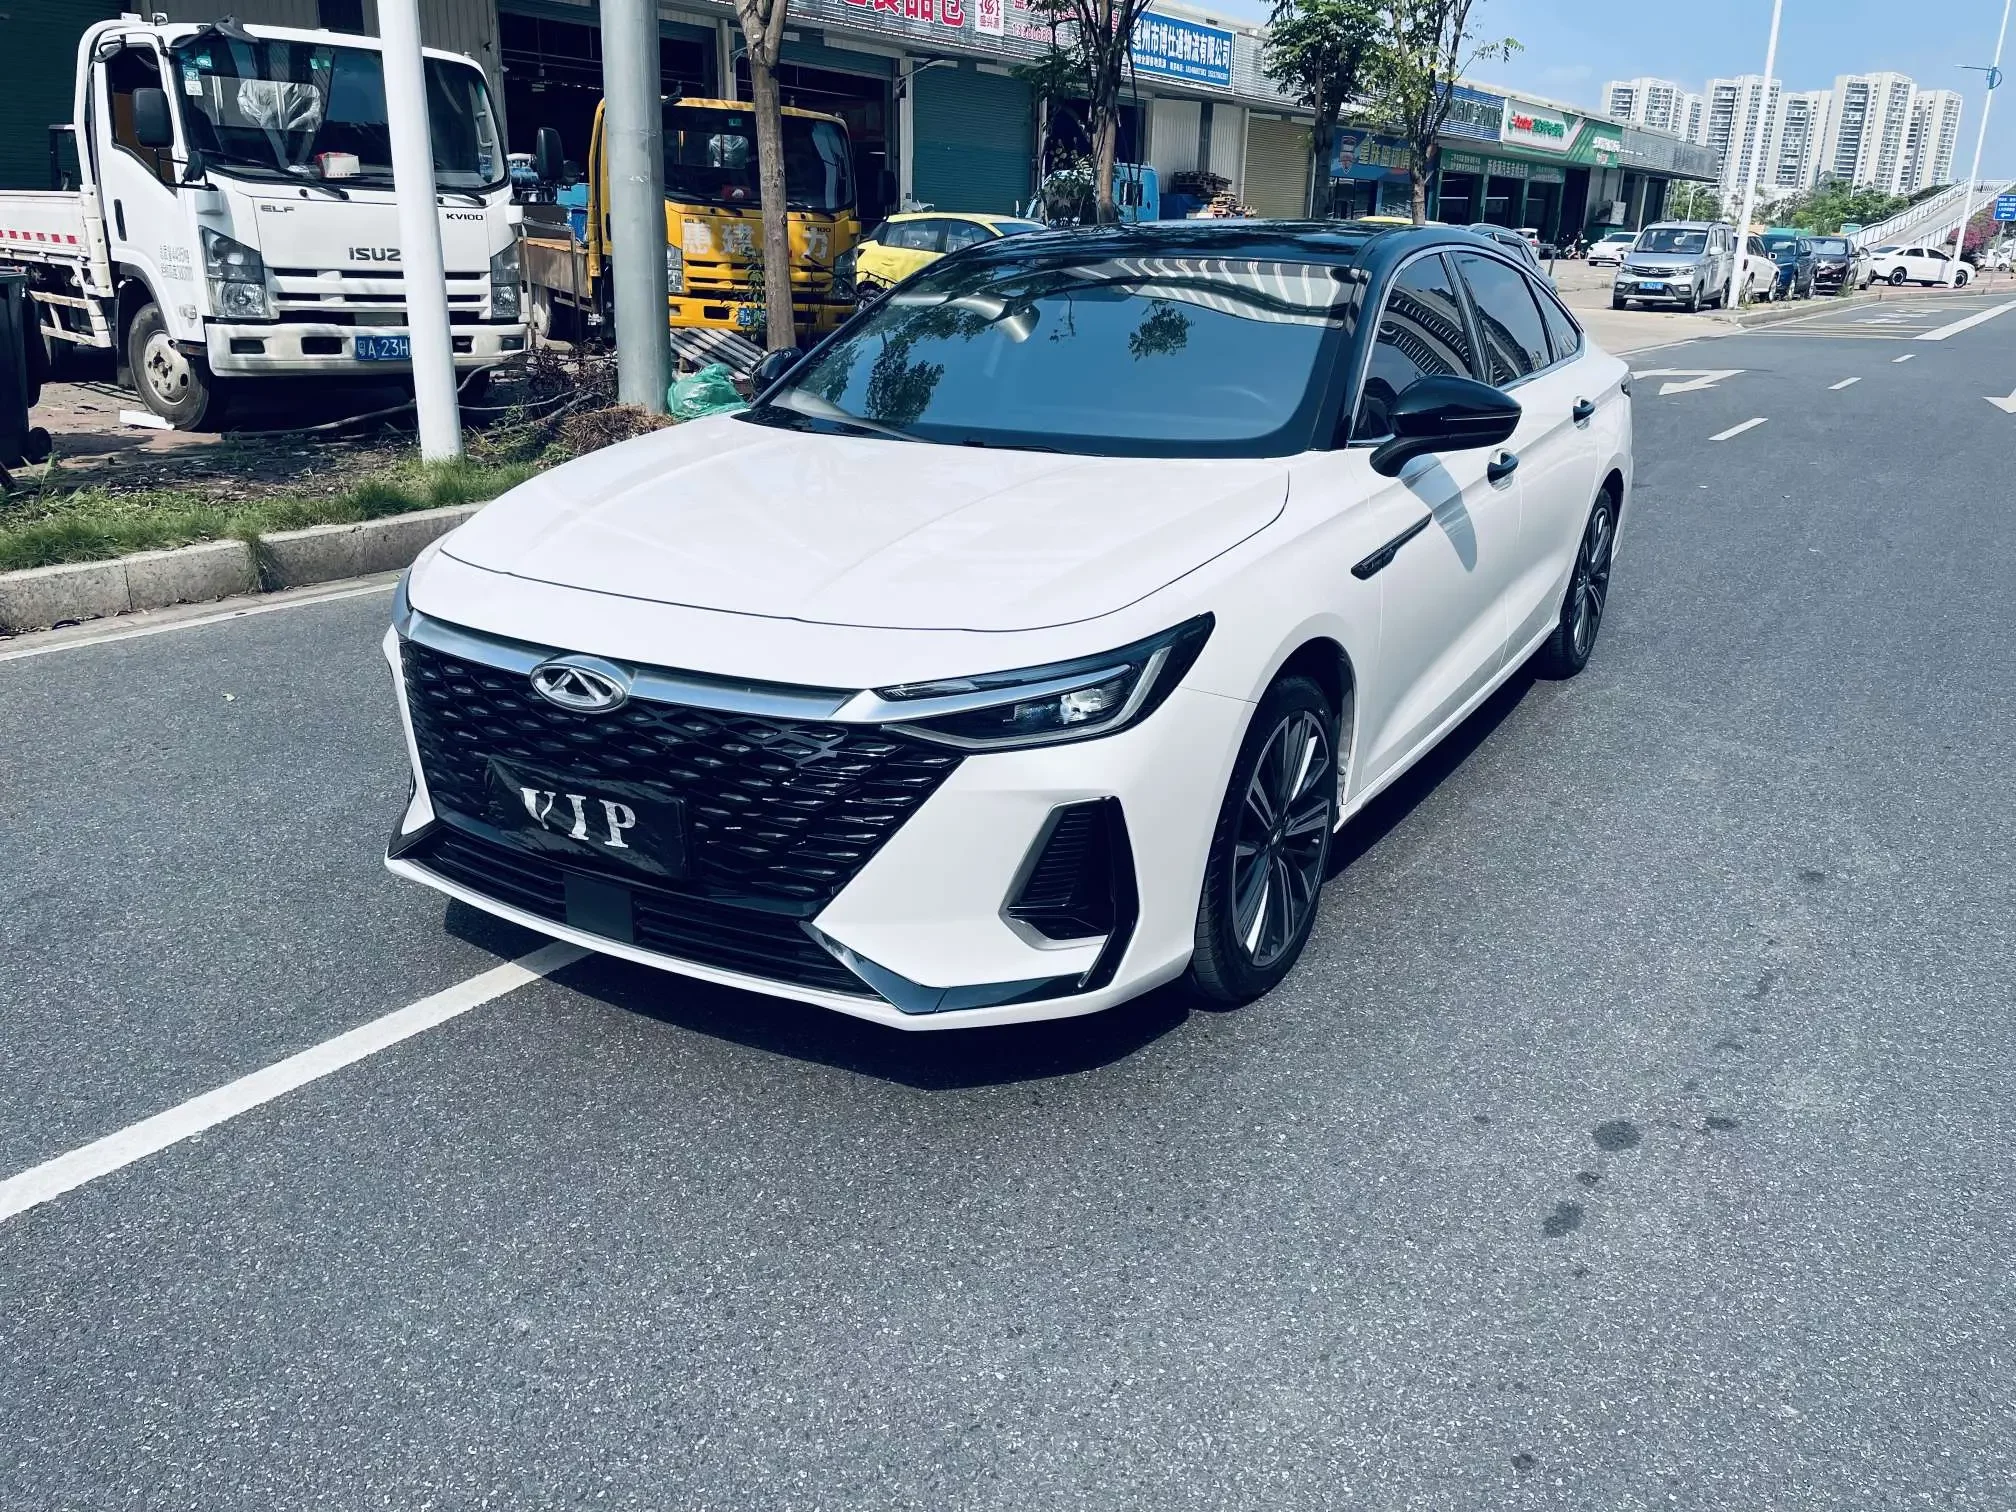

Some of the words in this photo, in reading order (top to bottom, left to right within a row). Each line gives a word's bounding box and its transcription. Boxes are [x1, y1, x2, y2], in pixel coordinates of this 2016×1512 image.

[260, 204, 295, 213] ELF
[446, 213, 484, 221] KV100
[519, 787, 636, 849] VIP
